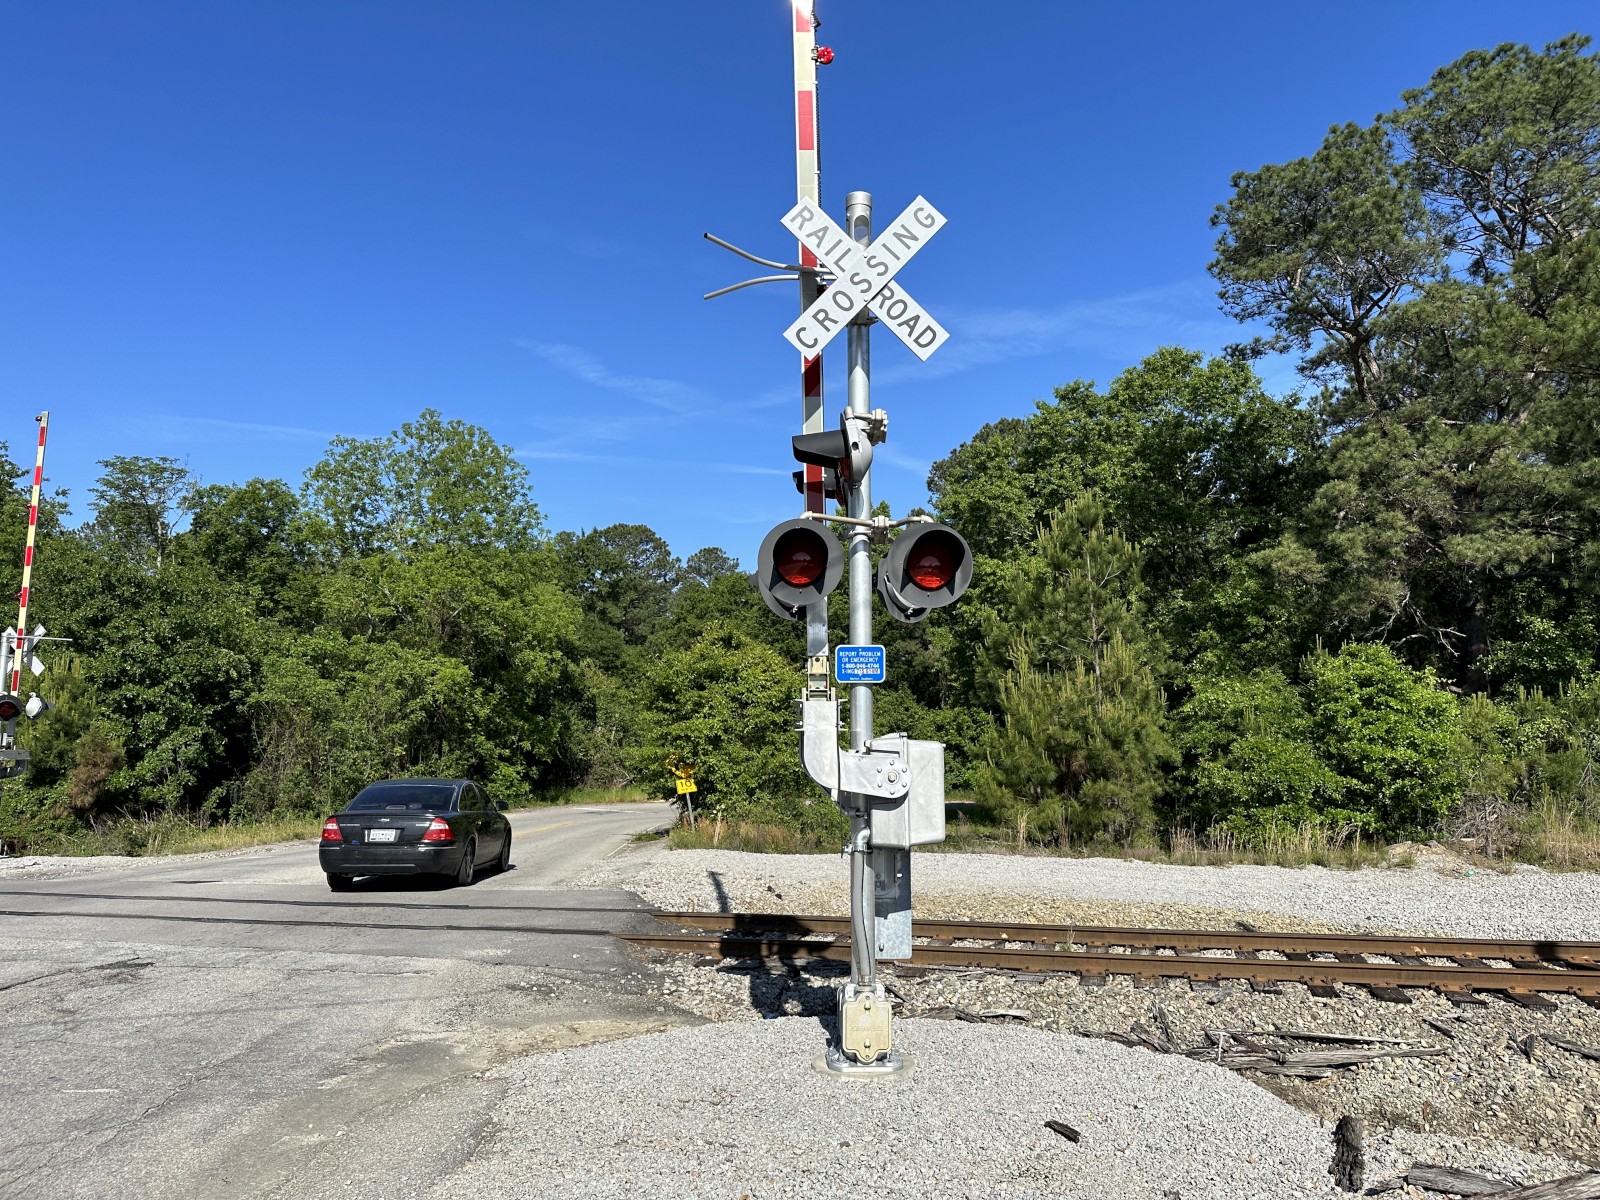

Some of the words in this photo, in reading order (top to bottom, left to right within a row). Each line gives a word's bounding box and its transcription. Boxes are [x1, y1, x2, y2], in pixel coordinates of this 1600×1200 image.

[789, 204, 852, 273] RAIL
[872, 283, 937, 349] ROAD
[795, 206, 936, 349] CROSSING
